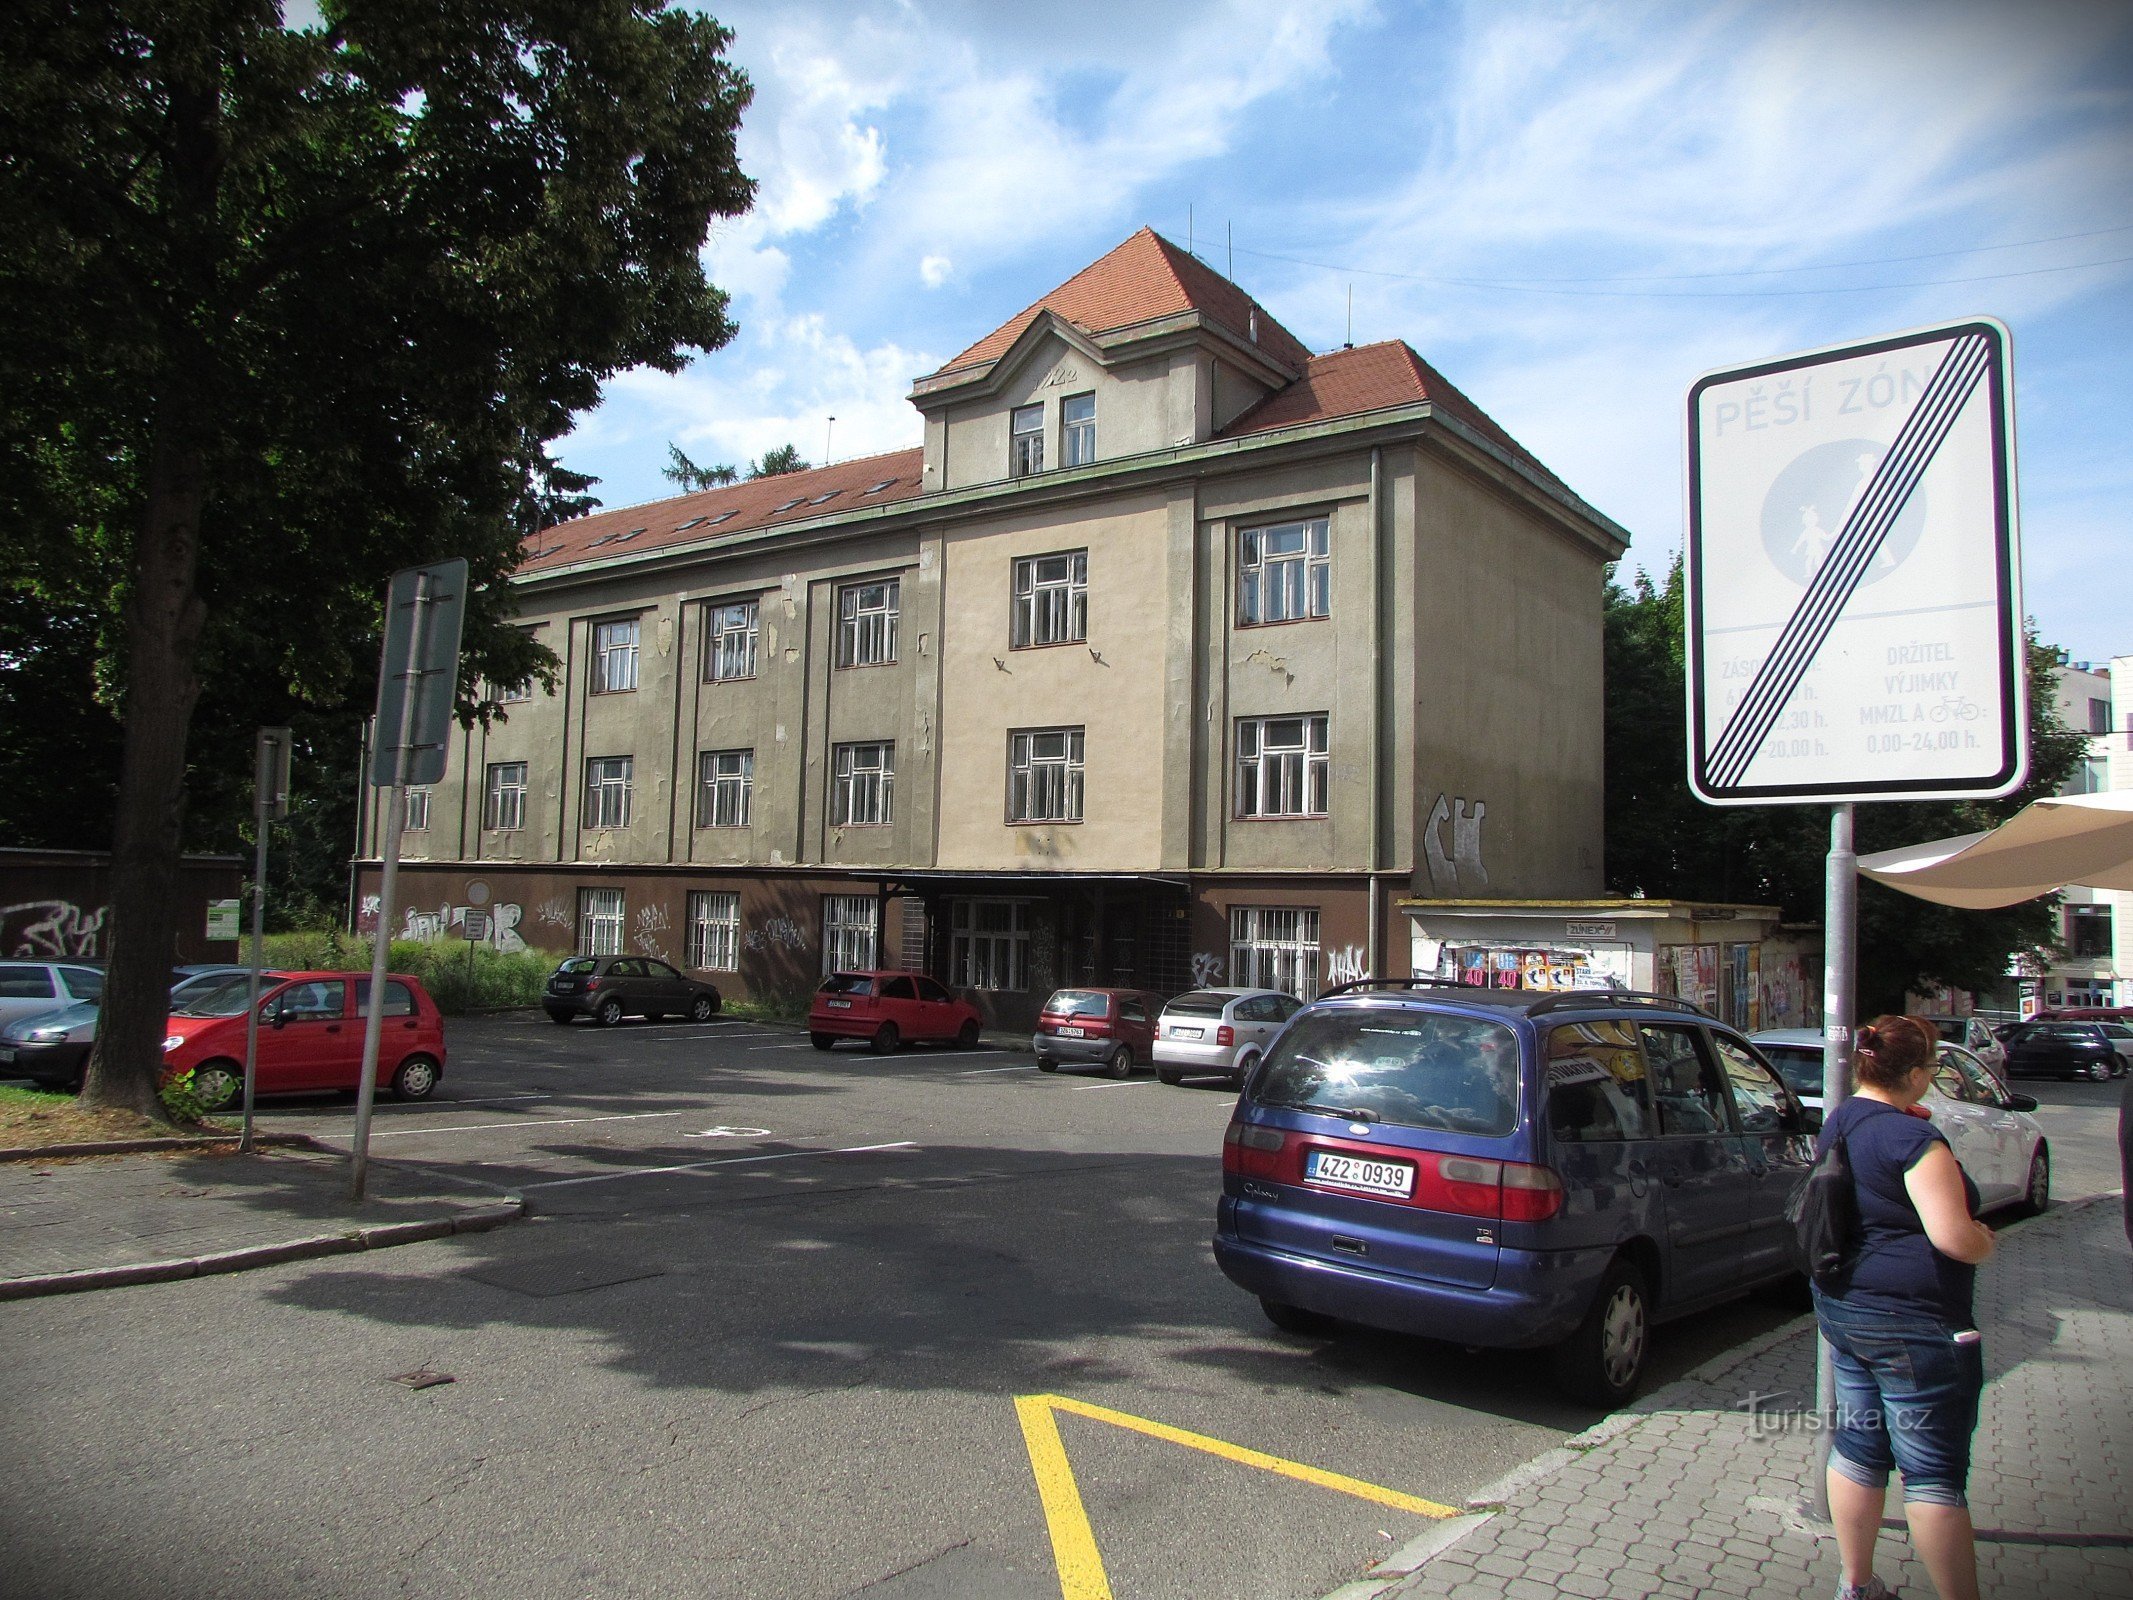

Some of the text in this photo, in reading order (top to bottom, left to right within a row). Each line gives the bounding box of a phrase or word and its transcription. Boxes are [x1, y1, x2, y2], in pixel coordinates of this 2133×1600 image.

[1716, 375, 1812, 437] PĚŠÍ
[1887, 640, 1955, 665] DRŽITEL
[1884, 671, 1958, 694] VÝJIMKY
[1860, 702, 1925, 725] MMZL A
[1465, 968, 1483, 985] 40
[1498, 970, 1516, 987] 40
[1320, 1156, 1351, 1180] 4Z2
[1362, 1163, 1405, 1188] 0939
